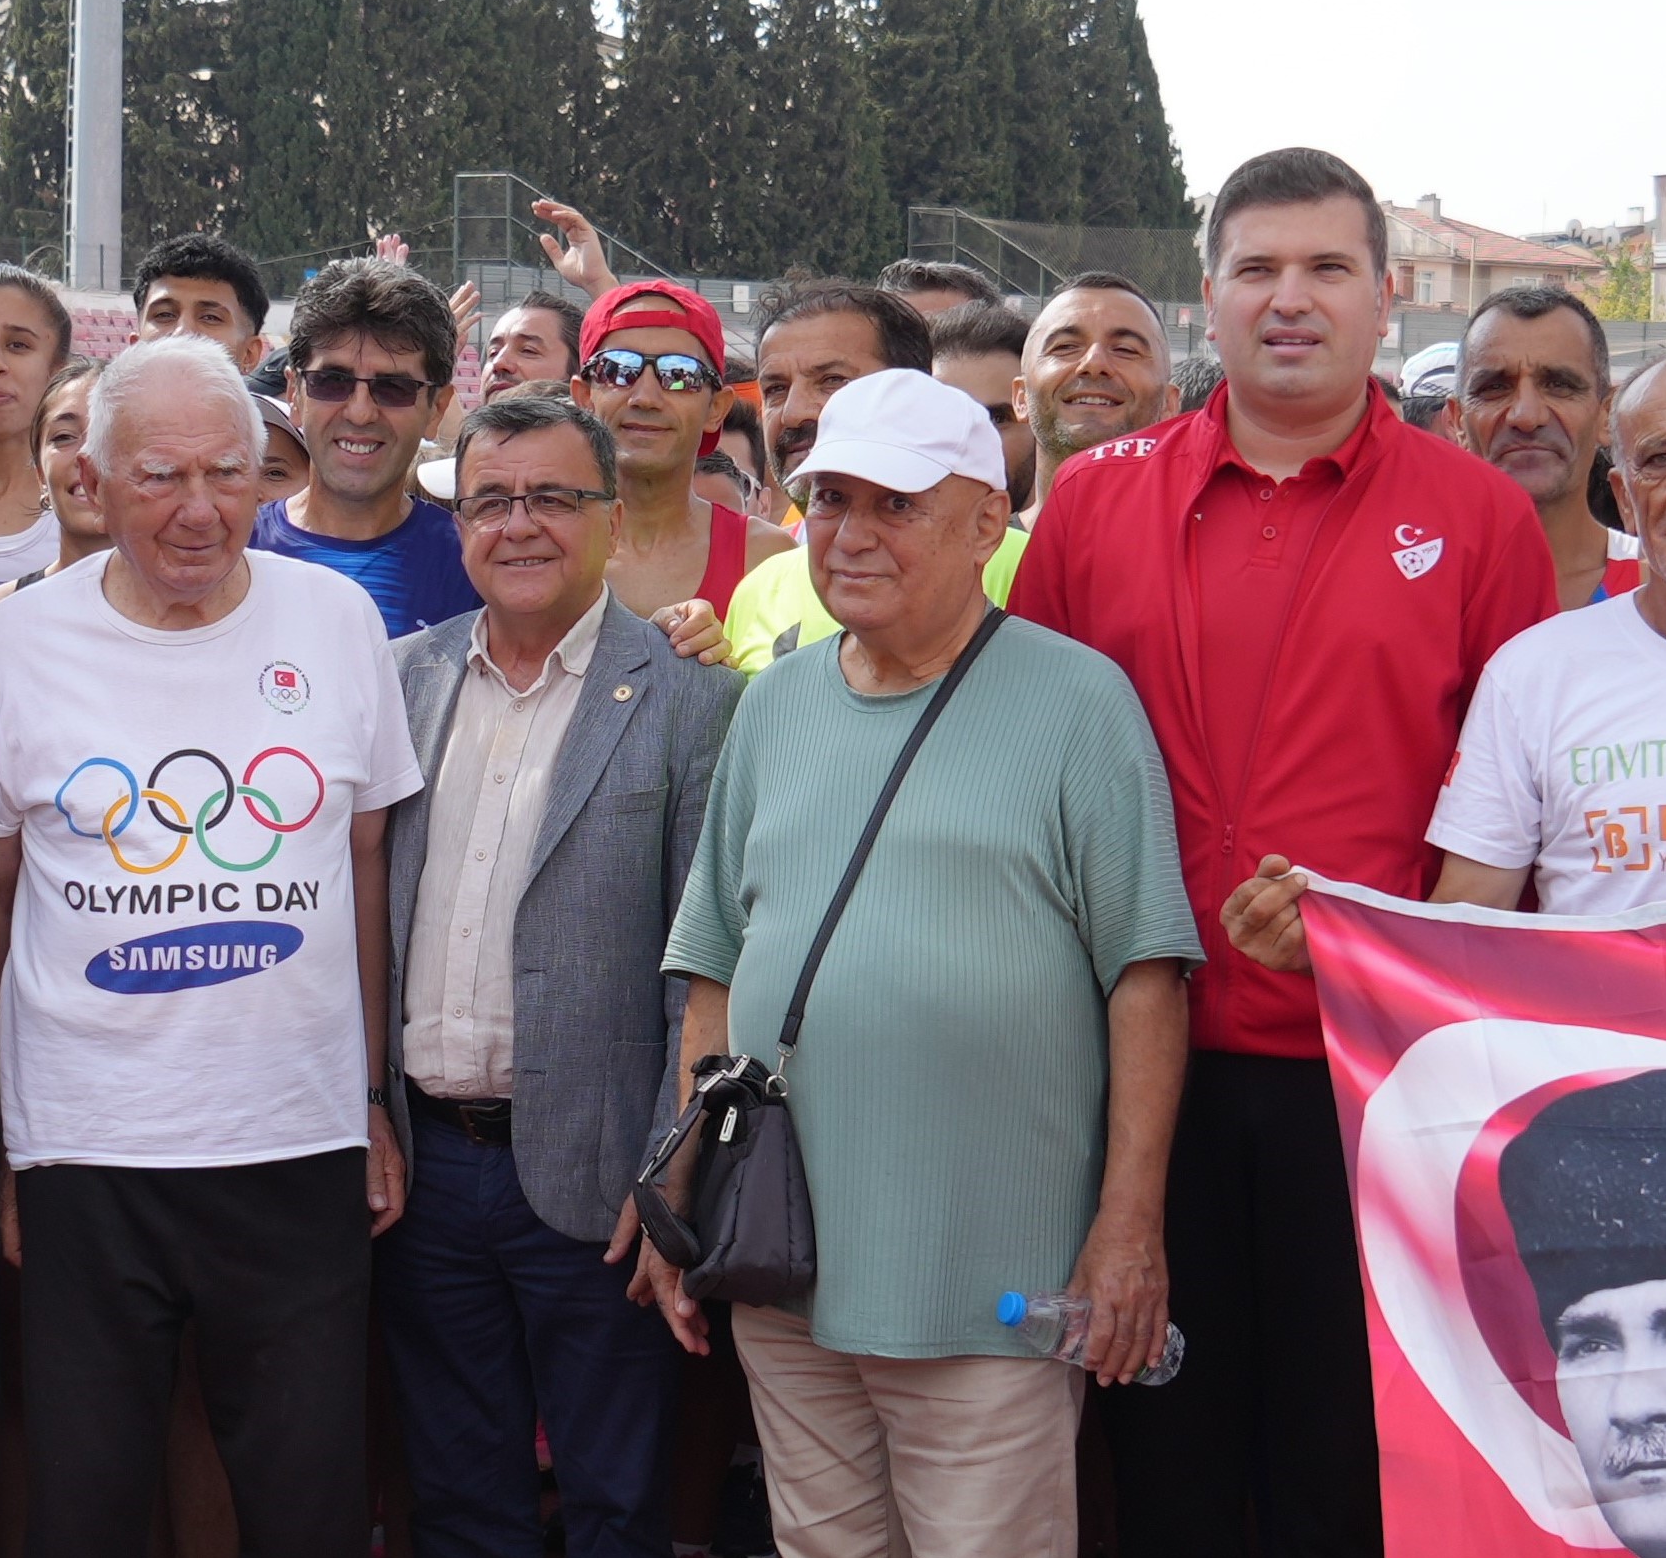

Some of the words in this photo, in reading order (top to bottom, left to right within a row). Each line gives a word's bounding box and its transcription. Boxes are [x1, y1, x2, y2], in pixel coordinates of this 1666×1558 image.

[1086, 438, 1157, 461] TFF
[64, 880, 241, 915] OLYMPIC
[256, 880, 320, 913] DAY
[107, 944, 278, 972] SAMSUNG
